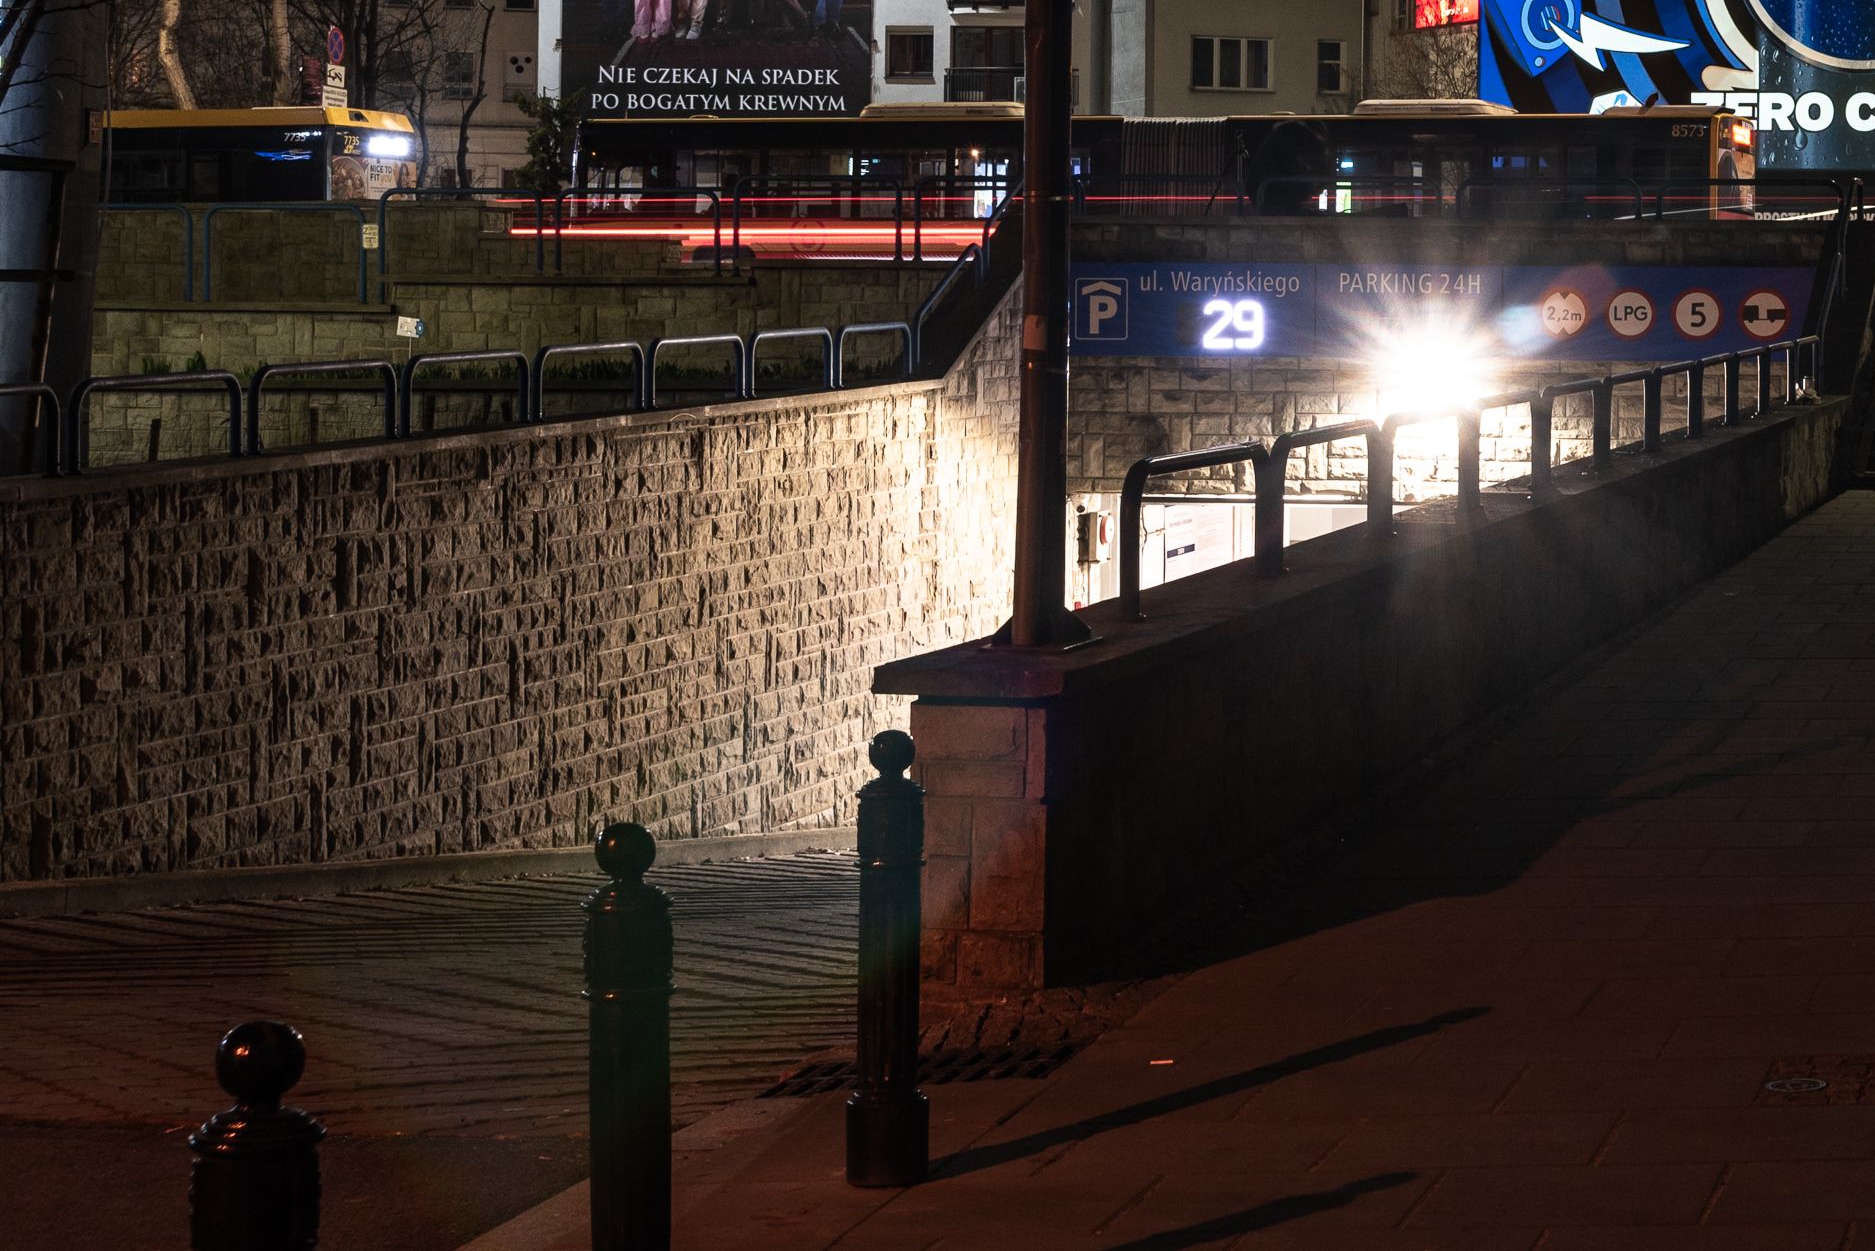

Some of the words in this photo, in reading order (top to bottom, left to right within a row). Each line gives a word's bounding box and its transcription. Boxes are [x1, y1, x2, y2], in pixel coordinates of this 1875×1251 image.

[597, 64, 637, 84] NIE
[643, 67, 718, 88] CZEKAJ
[726, 68, 756, 84] NA
[762, 69, 840, 85] SPADEK
[591, 93, 620, 110] PO
[627, 94, 732, 110] BOGATYM
[739, 95, 847, 111] KREWNYM
[284, 132, 306, 143] 7735
[1672, 123, 1704, 137] 8573
[343, 135, 360, 146] 7735
[370, 165, 384, 173] NICE
[385, 166, 392, 174] TO
[1140, 270, 1164, 292] ul.
[1171, 270, 1300, 298] Waryńskiego
[1339, 273, 1433, 294] PARKING
[1439, 273, 1482, 295] 24H
[1089, 295, 1118, 334] P
[1547, 306, 1582, 323] 2,2m
[1613, 305, 1648, 321] LPG
[1690, 302, 1707, 328] 5
[1200, 298, 1266, 351] 29
